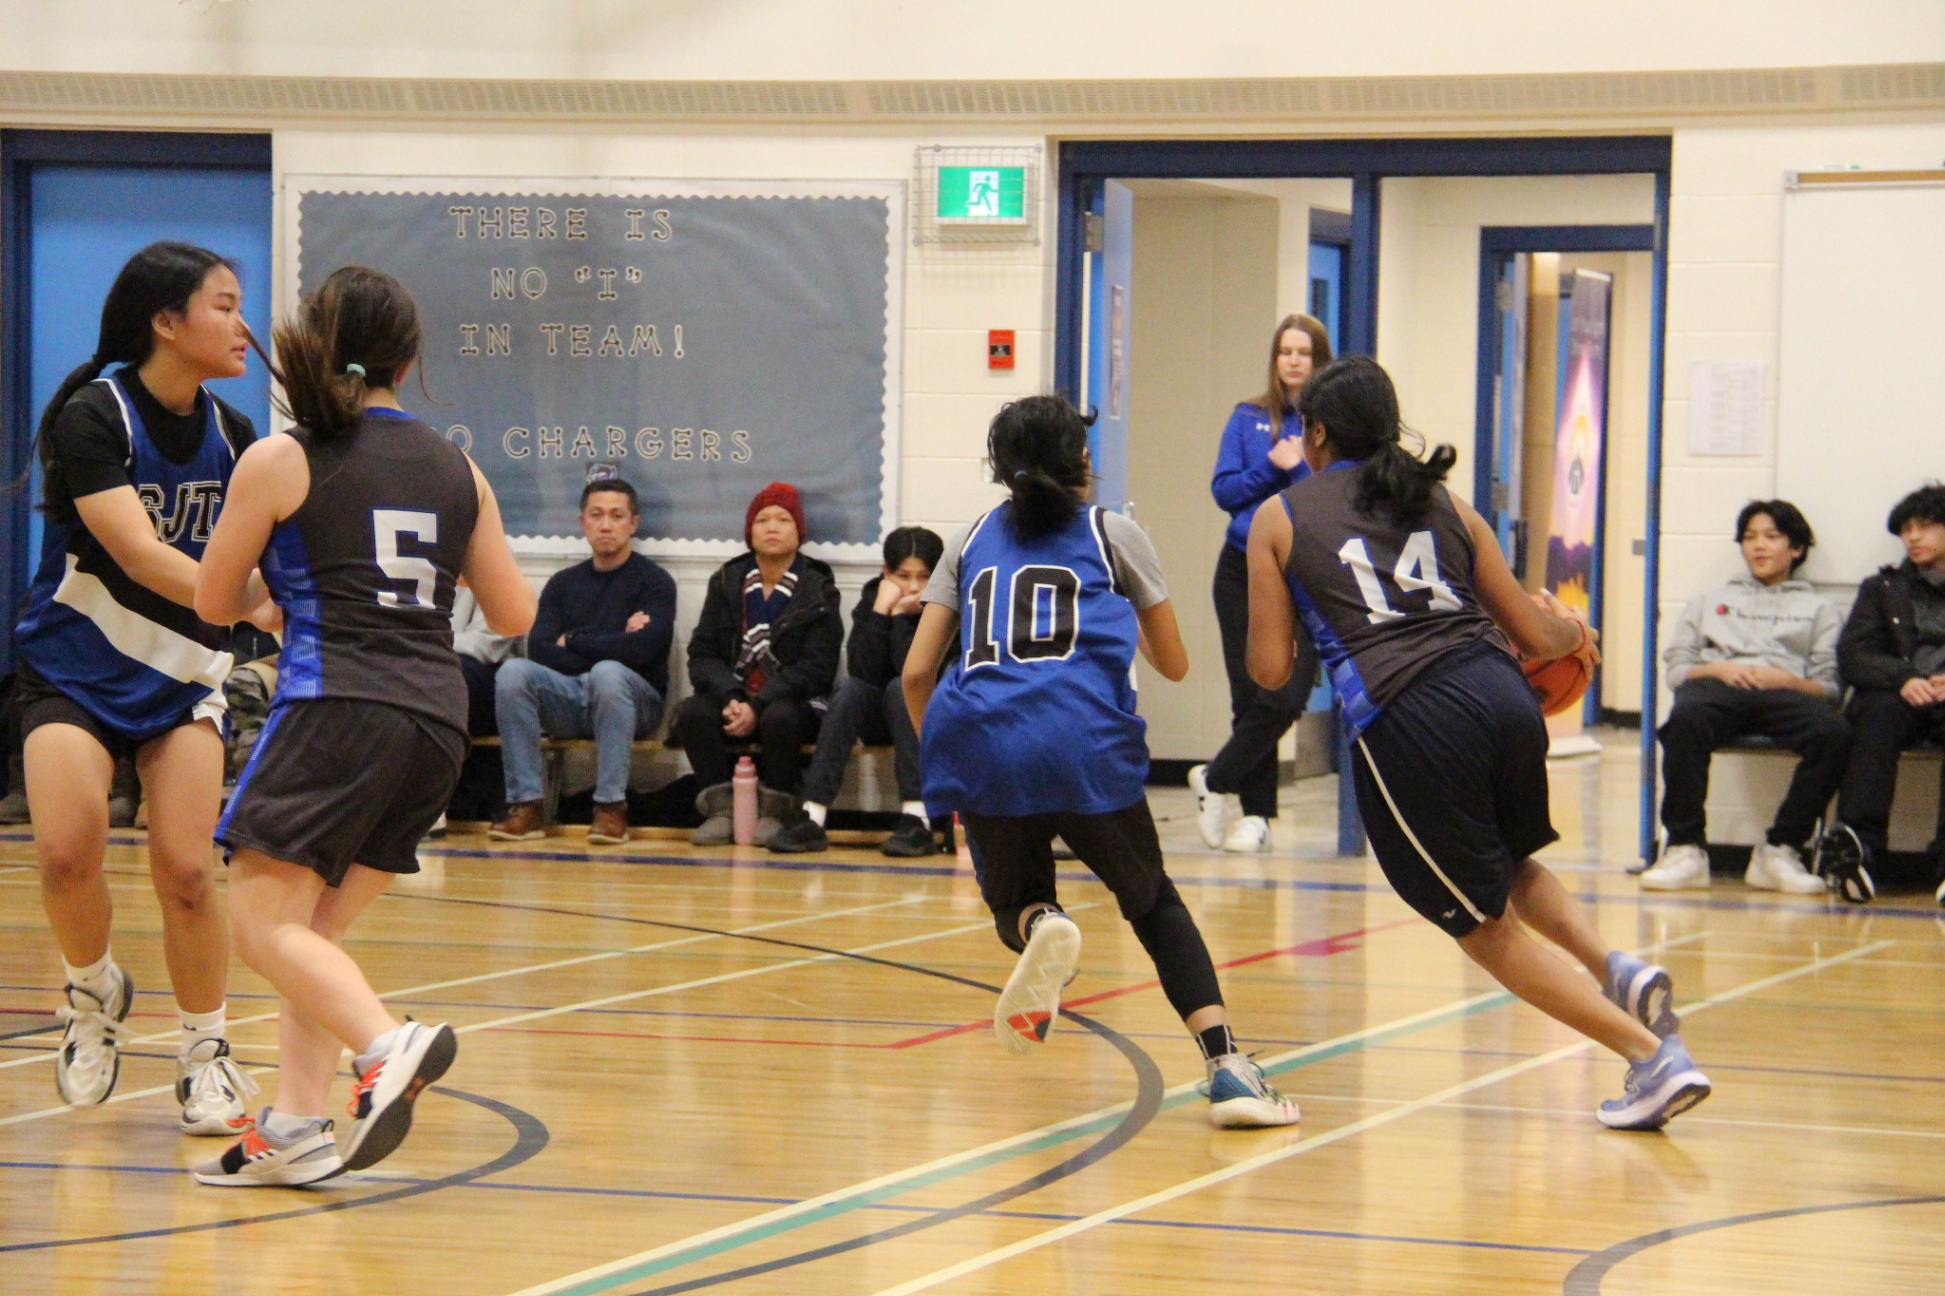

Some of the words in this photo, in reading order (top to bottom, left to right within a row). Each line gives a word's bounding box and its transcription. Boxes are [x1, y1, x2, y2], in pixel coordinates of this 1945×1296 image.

[449, 207, 589, 240] THERE
[625, 209, 674, 242] IS
[490, 267, 548, 300] NO
[459, 324, 512, 356] IN
[541, 324, 686, 359] TEAM!
[430, 424, 473, 454] O
[502, 426, 754, 463] CHARGERS
[373, 509, 438, 609] 5
[1337, 530, 1463, 626] 14
[965, 564, 1081, 671] 10
